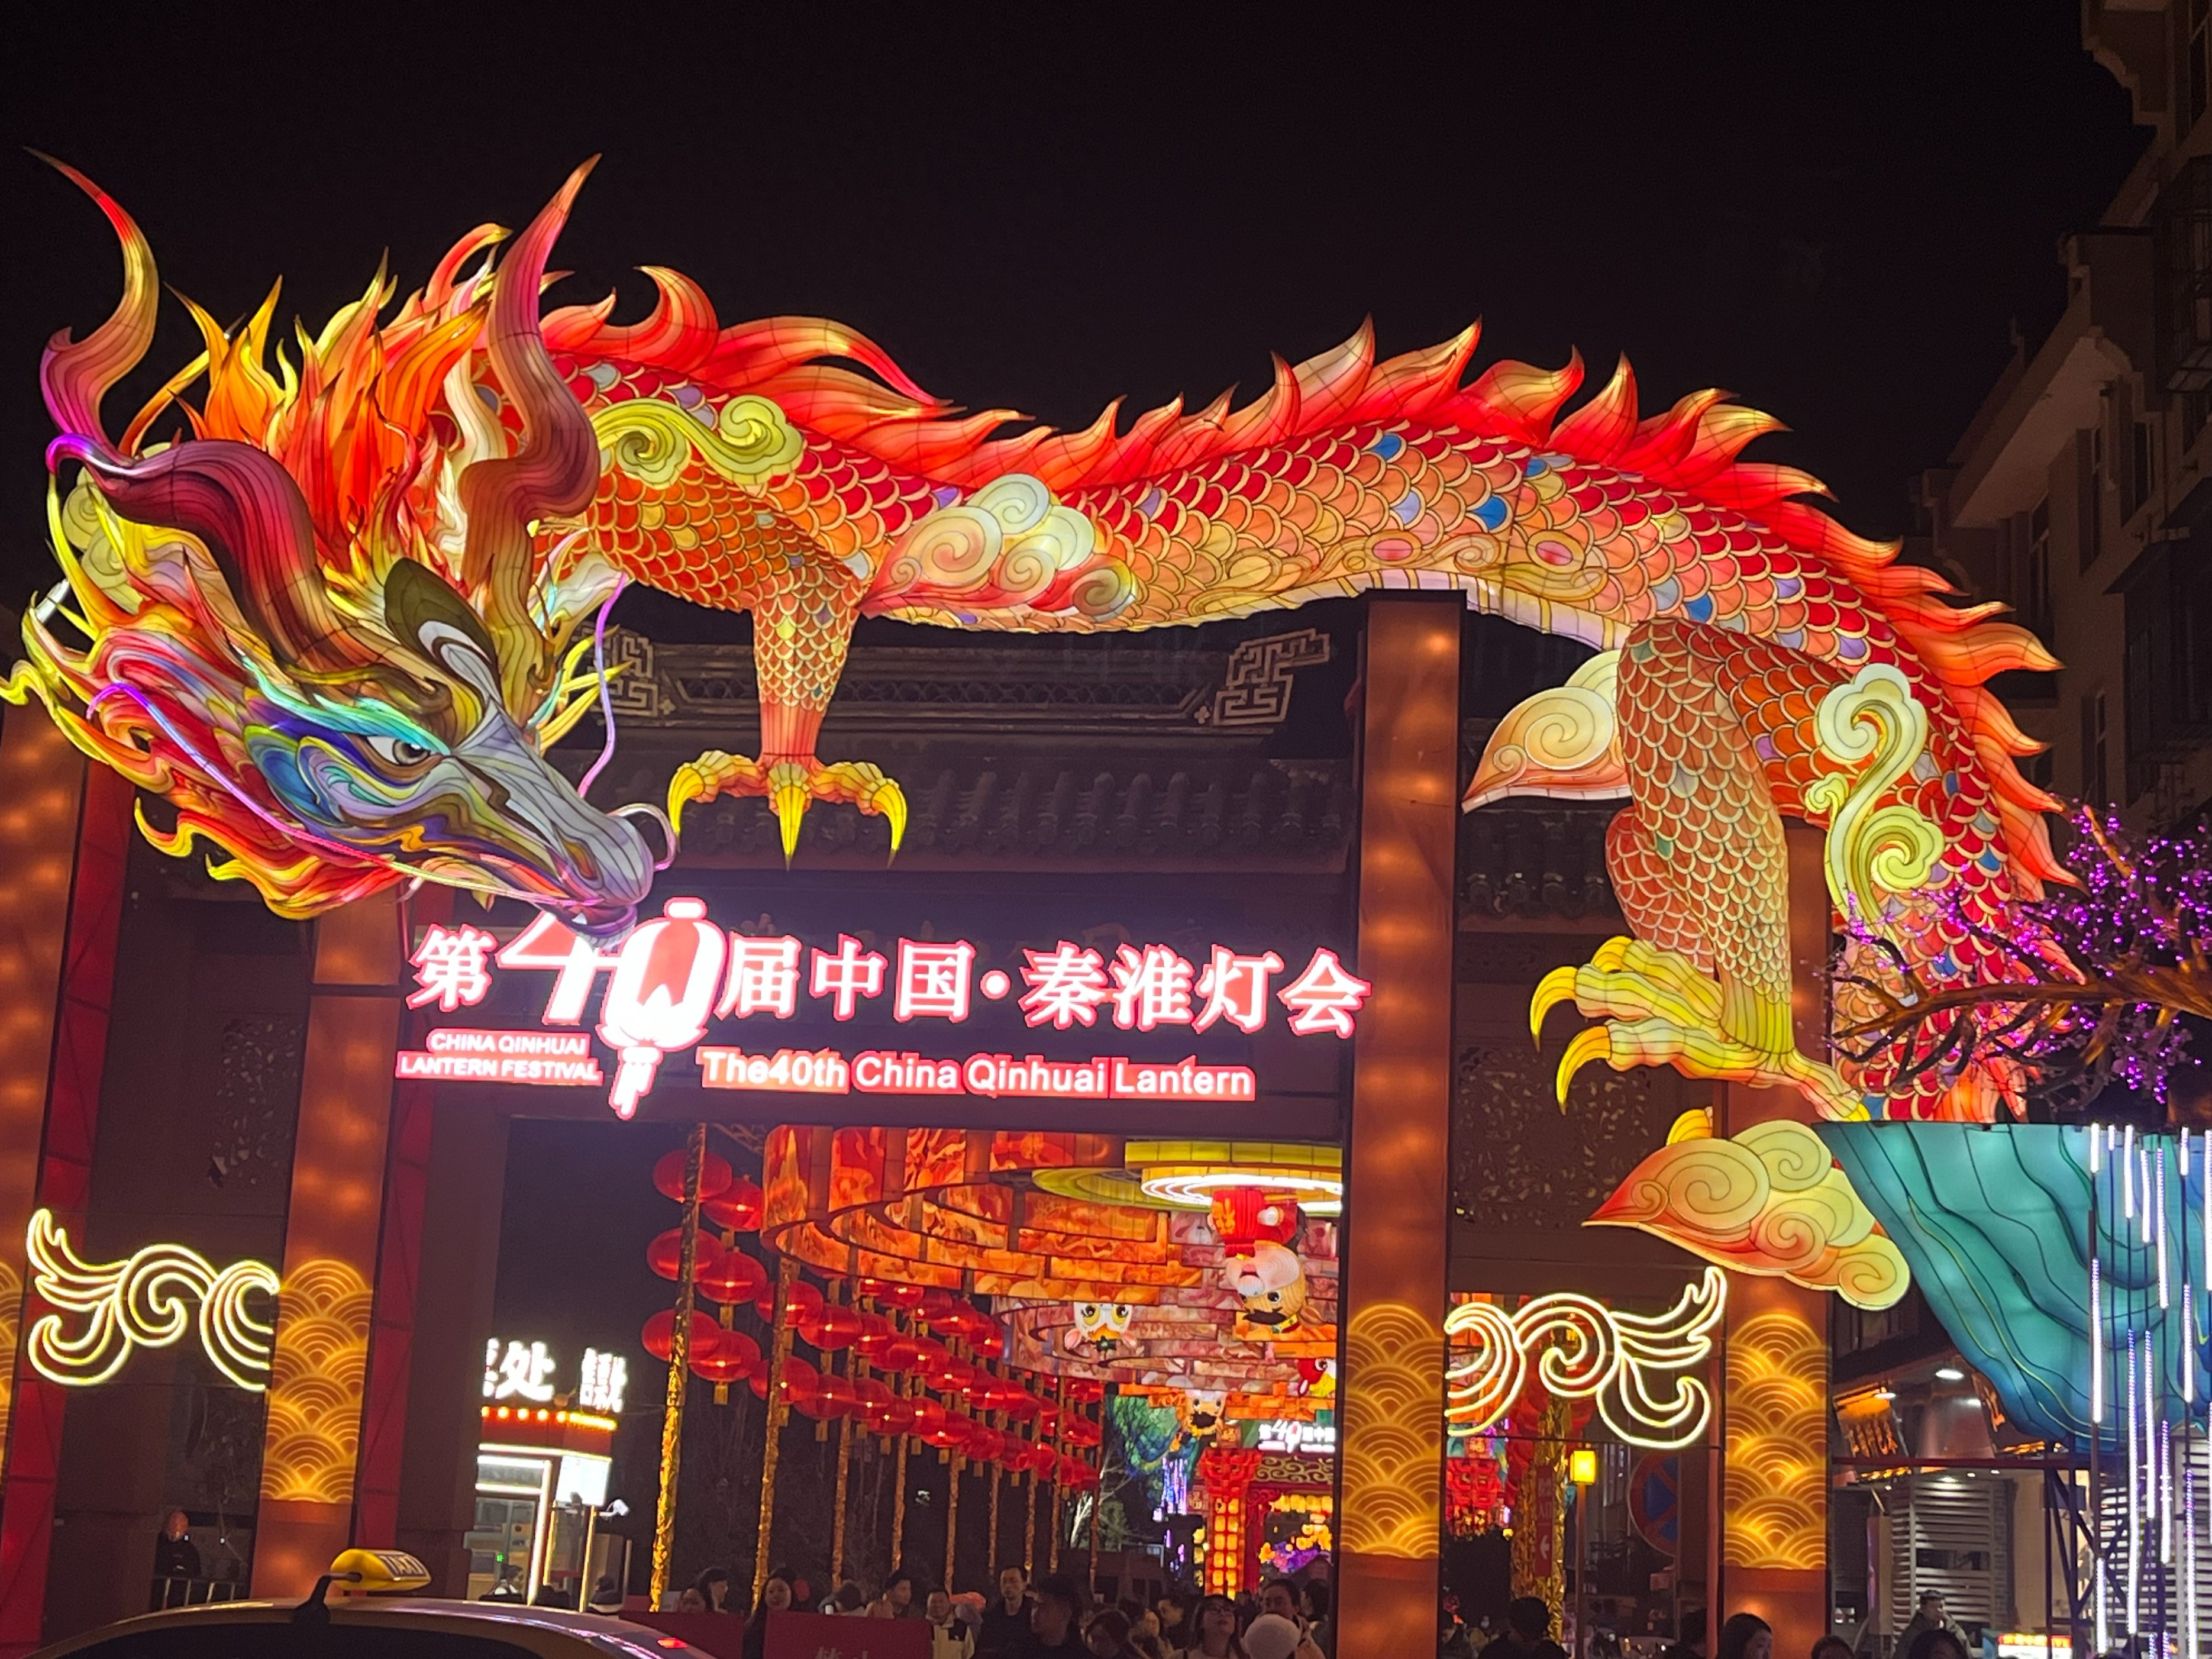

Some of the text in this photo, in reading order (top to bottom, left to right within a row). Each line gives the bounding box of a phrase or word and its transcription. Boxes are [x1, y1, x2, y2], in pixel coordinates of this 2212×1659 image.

[431, 1032, 586, 1056] CHINA QINHUAI
[400, 1056, 600, 1081] LANTERN FESTIVAL
[702, 1051, 1251, 1095] The40th China Qinhuai Lantern
[379, 1555, 425, 1574] TAXI
